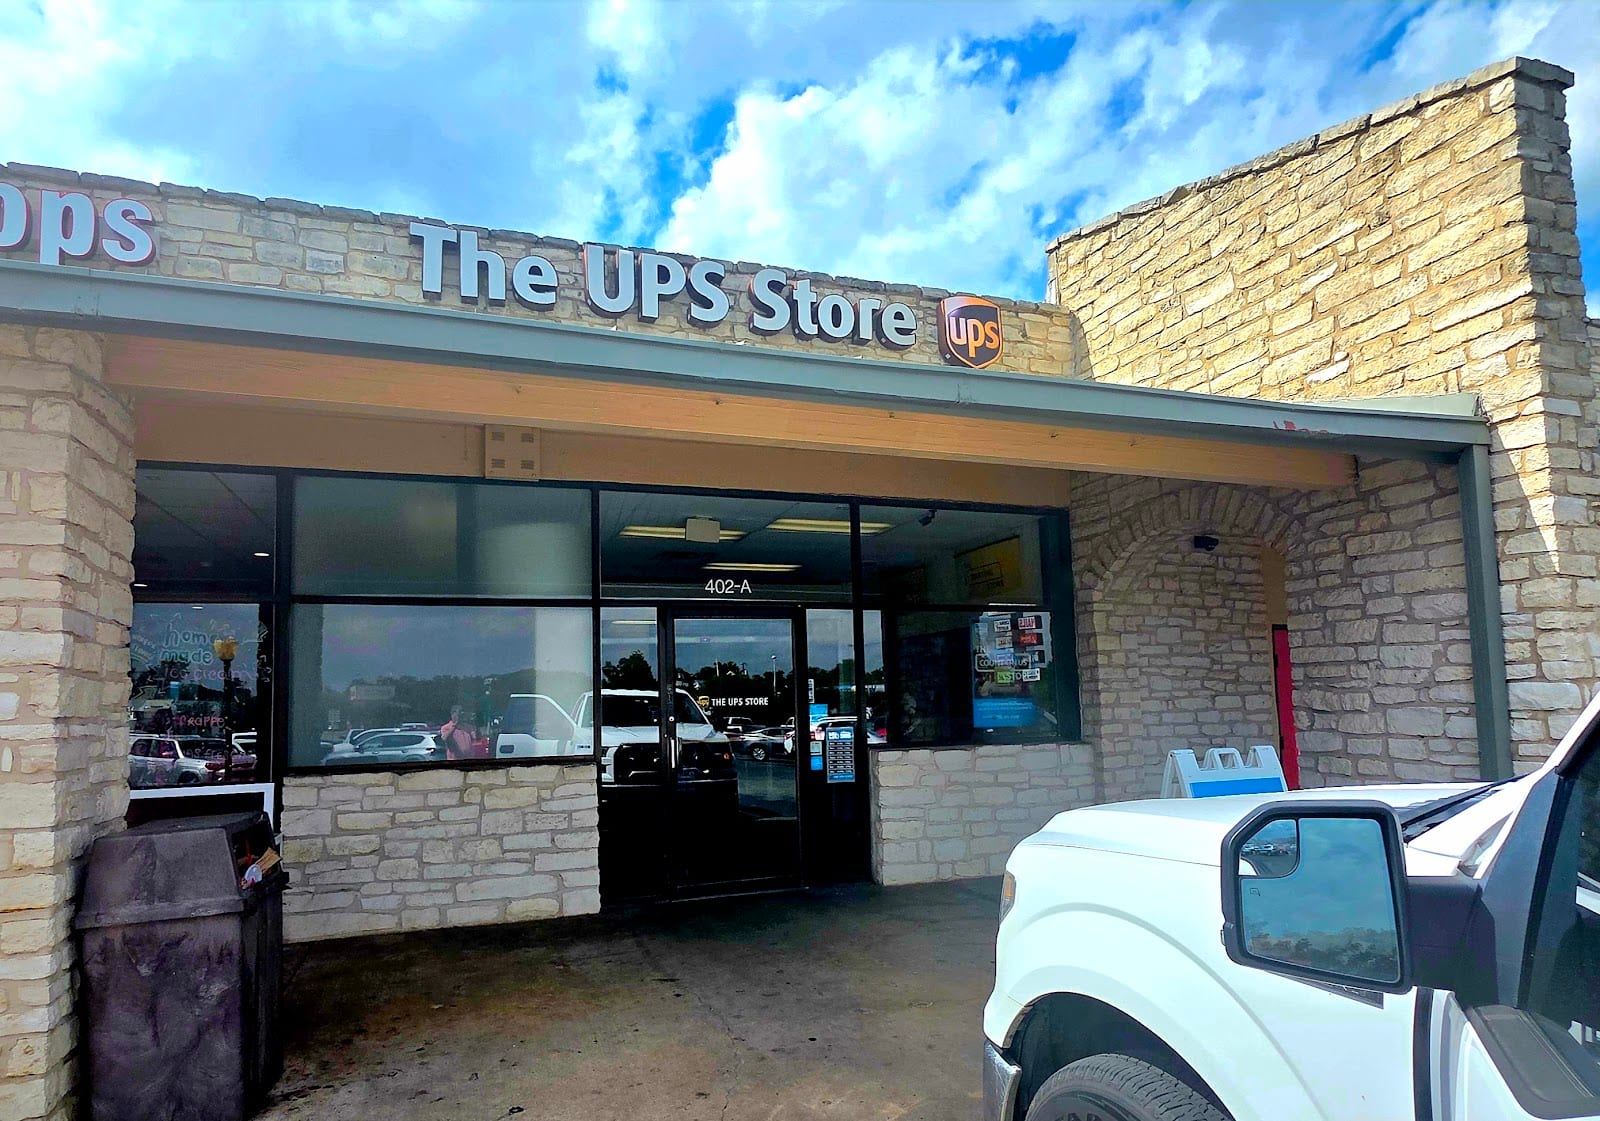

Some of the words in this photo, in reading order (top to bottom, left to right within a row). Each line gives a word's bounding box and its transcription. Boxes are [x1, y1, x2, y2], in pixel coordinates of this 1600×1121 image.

[409, 221, 558, 307] The
[583, 243, 731, 325] UPS
[750, 269, 917, 348] Store
[949, 316, 1000, 358] ups
[704, 579, 753, 594] 402-A
[711, 698, 727, 707] THE
[728, 698, 744, 707] UPS
[745, 697, 769, 706] STORE
